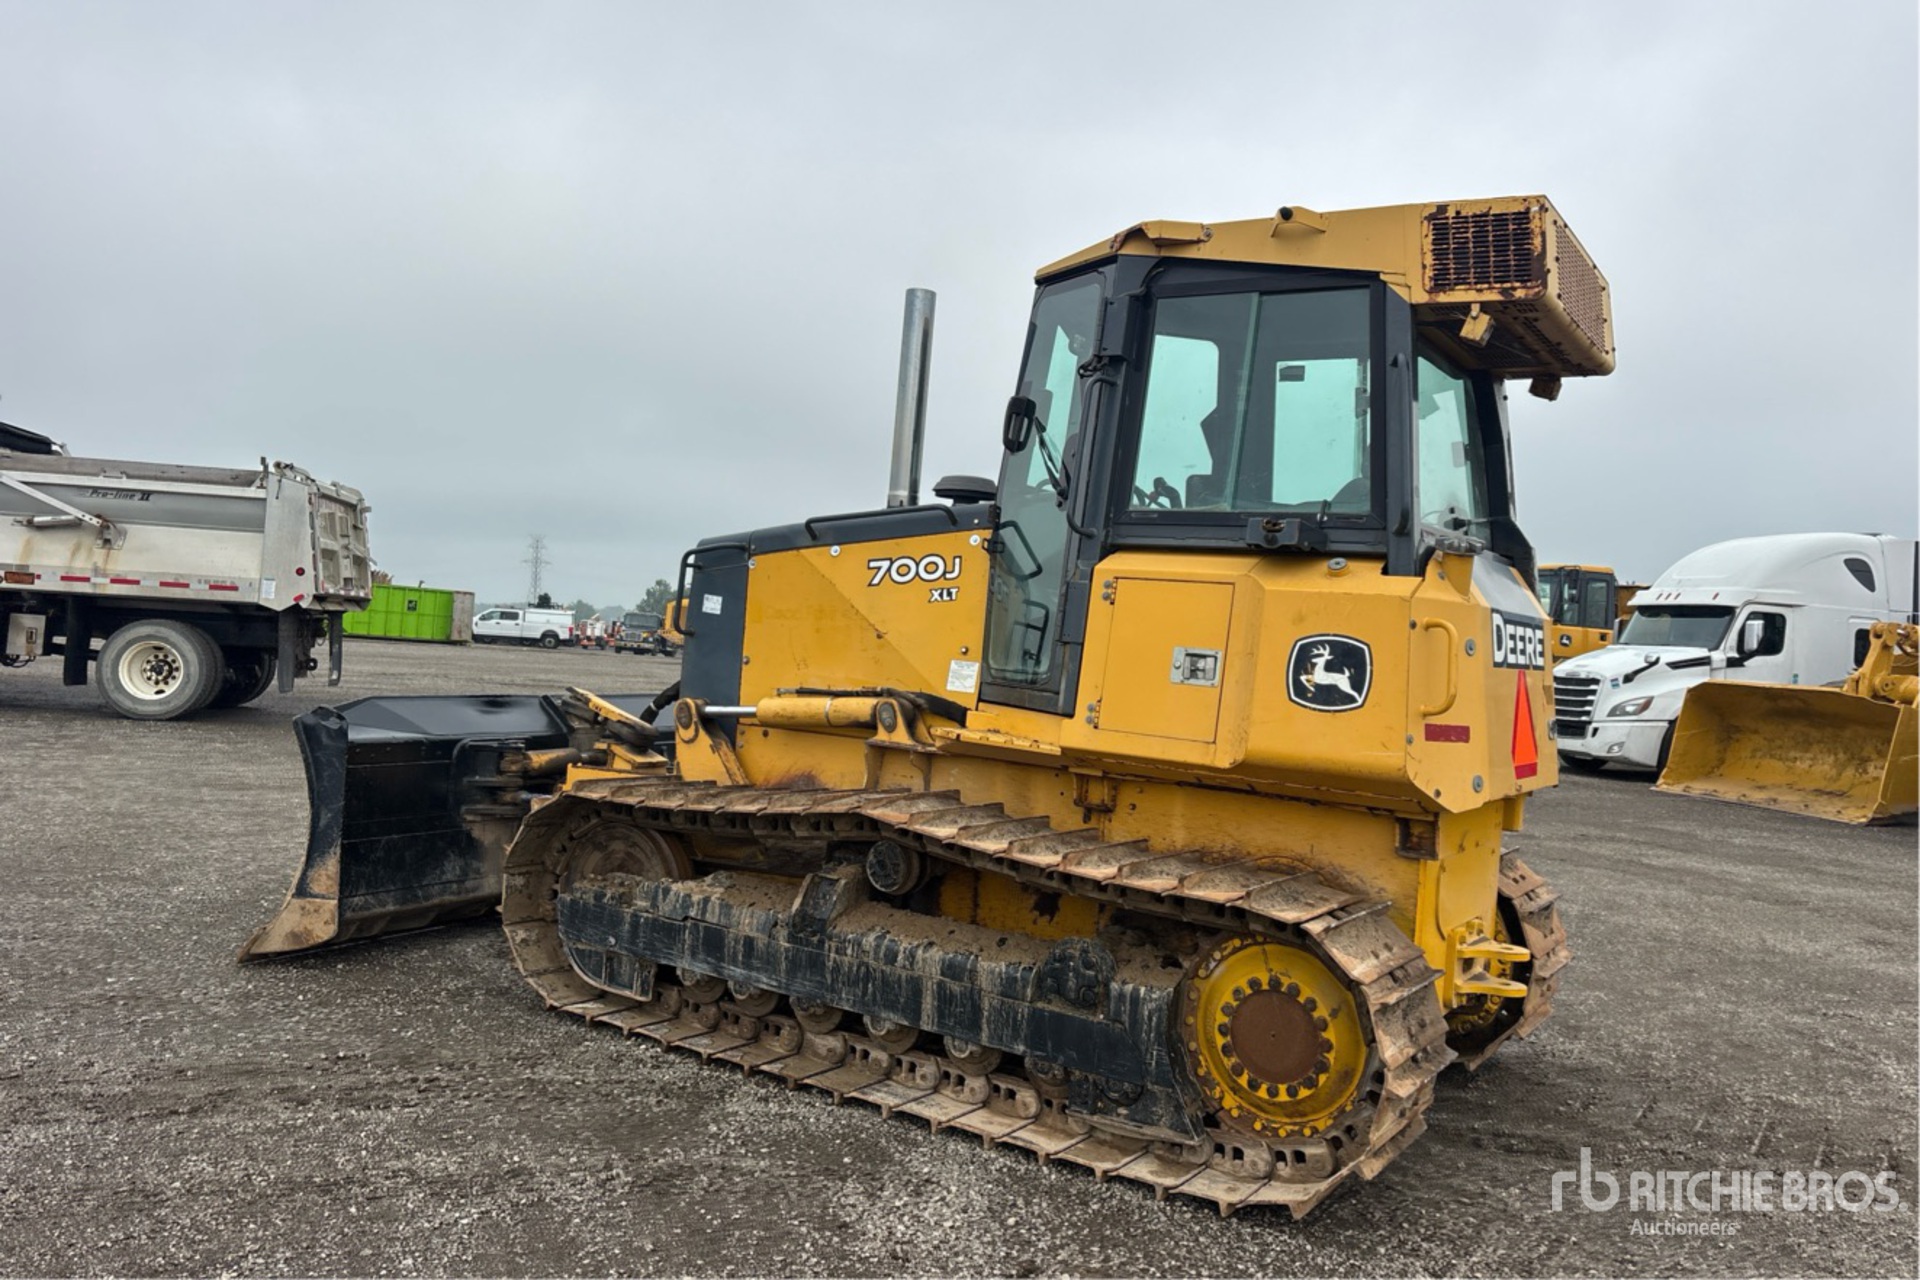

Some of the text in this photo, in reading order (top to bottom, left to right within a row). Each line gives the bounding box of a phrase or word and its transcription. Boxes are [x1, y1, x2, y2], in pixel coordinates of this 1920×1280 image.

[138, 492, 153, 501] II
[867, 554, 962, 587] 700J
[928, 587, 959, 603] XLT
[1492, 612, 1544, 666] DEERE
